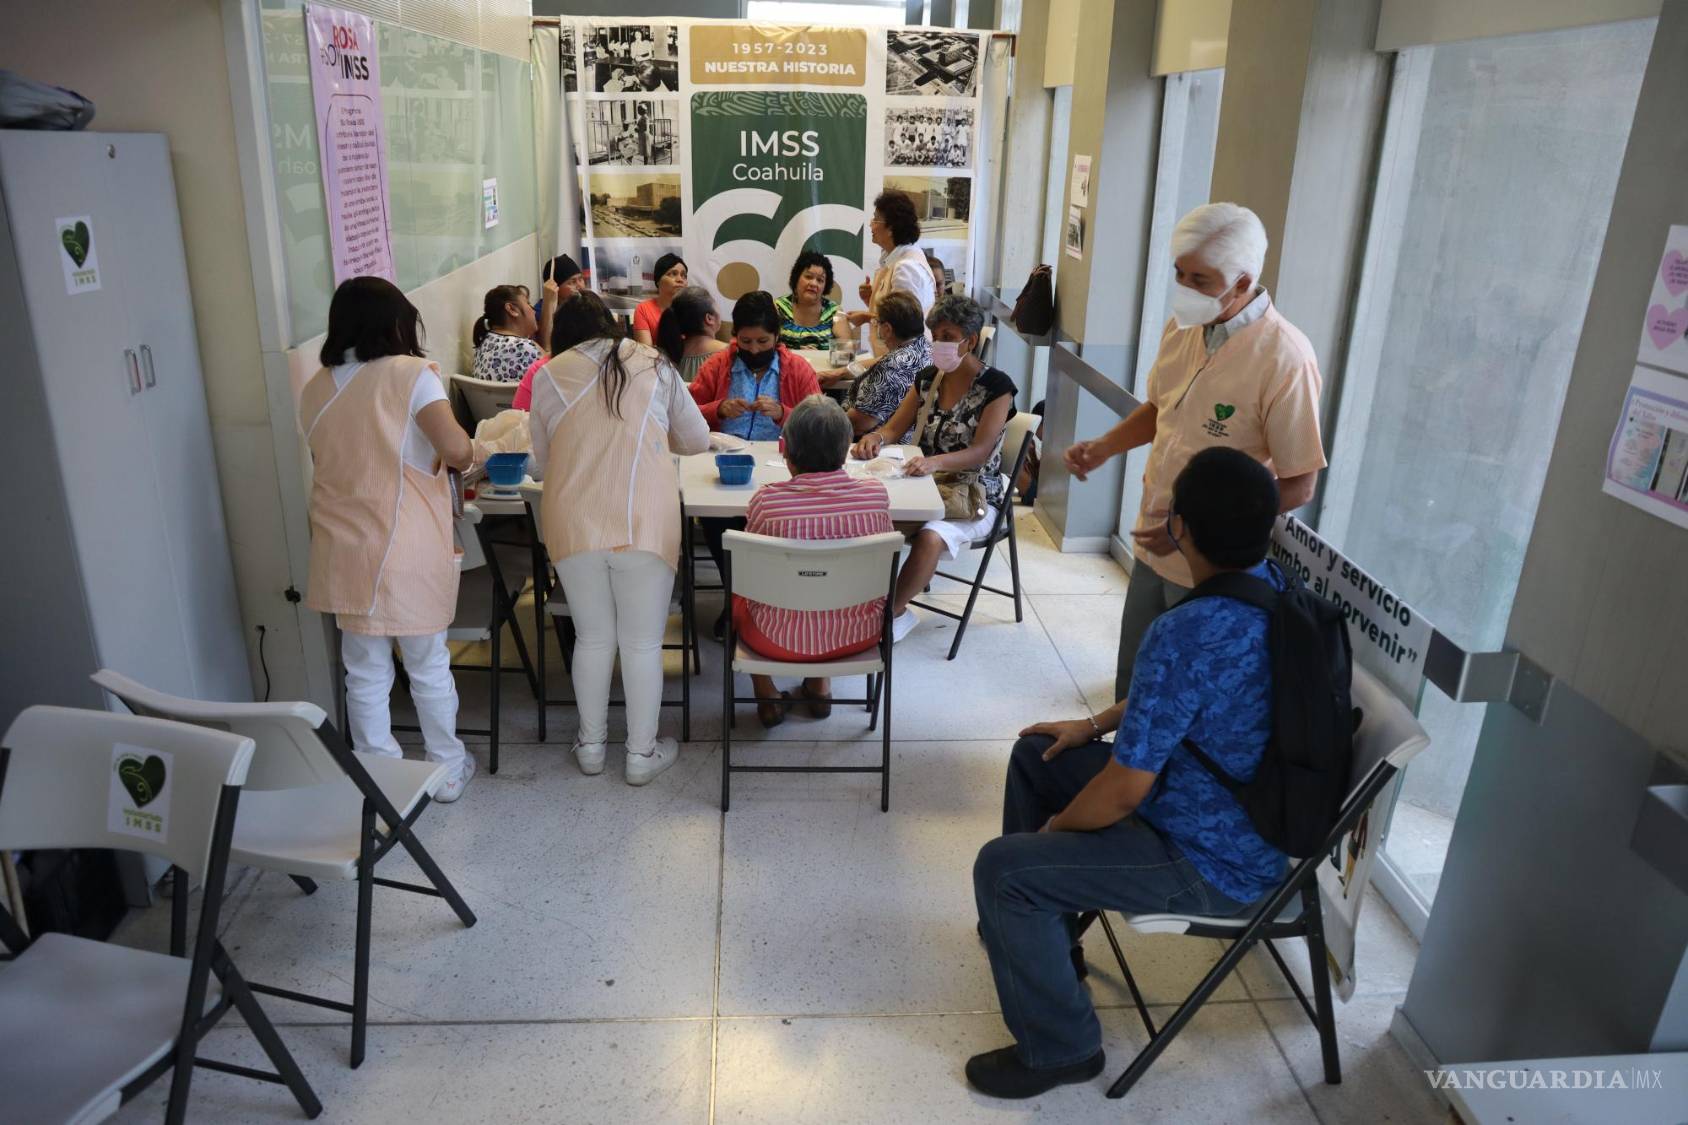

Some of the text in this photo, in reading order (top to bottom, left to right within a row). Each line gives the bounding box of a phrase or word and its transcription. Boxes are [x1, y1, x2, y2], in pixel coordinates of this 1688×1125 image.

[732, 42, 829, 56] 1957-2023
[704, 61, 856, 75] NUESTRA HISTORIA
[740, 130, 820, 157] IMSS
[732, 162, 824, 181] Coahuila
[1268, 539, 1310, 583] umbo
[1314, 576, 1329, 599] al
[1327, 550, 1339, 571] y
[1341, 561, 1411, 627] servicio
